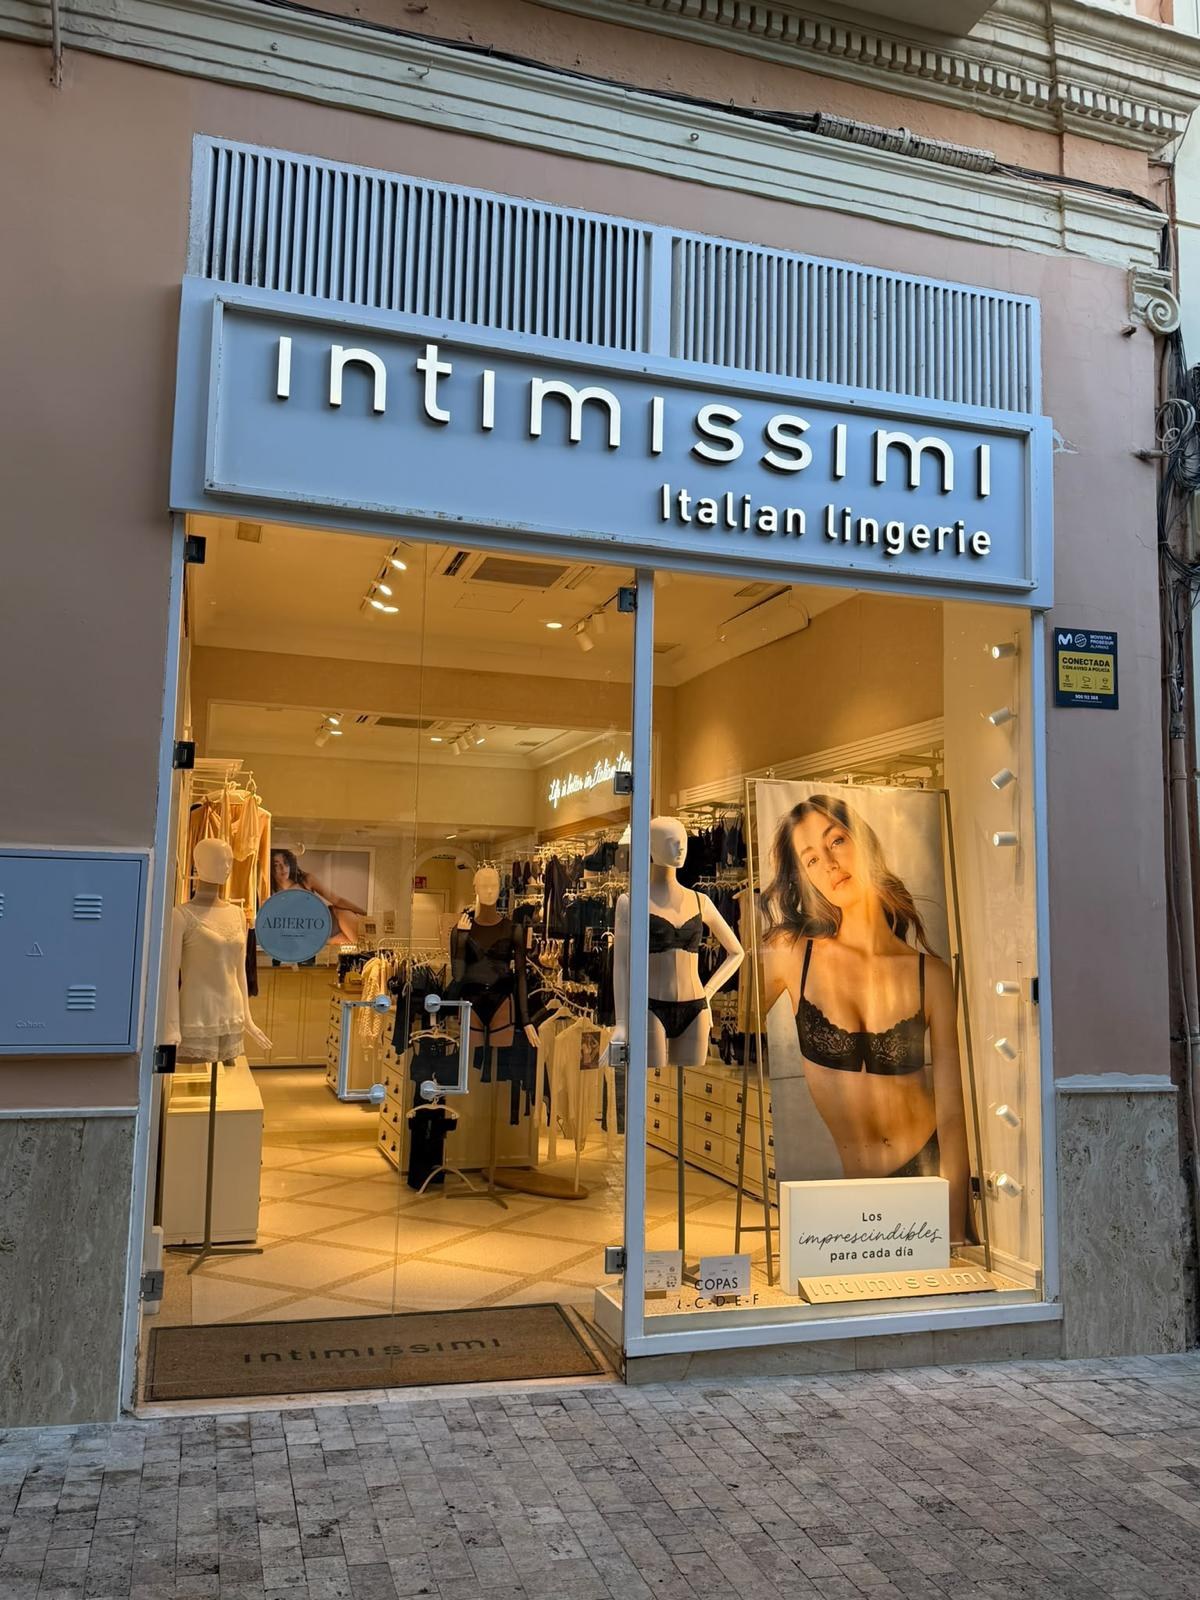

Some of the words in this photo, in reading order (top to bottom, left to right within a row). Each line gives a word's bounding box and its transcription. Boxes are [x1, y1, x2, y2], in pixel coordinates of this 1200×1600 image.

[276, 336, 991, 497] intimissimi
[660, 483, 806, 535] Italian
[824, 503, 992, 556] lingerie
[1062, 657, 1110, 667] CONECTADA
[262, 917, 325, 929] ABIERTO
[862, 1212, 882, 1222] Los
[798, 1221, 943, 1250] imprescindibles
[830, 1249, 857, 1263] para
[862, 1247, 890, 1260] cada
[895, 1246, 914, 1257] día
[694, 1277, 738, 1291] COPAS
[809, 1271, 988, 1297] intimissimi
[244, 1338, 500, 1363] intimissimi
